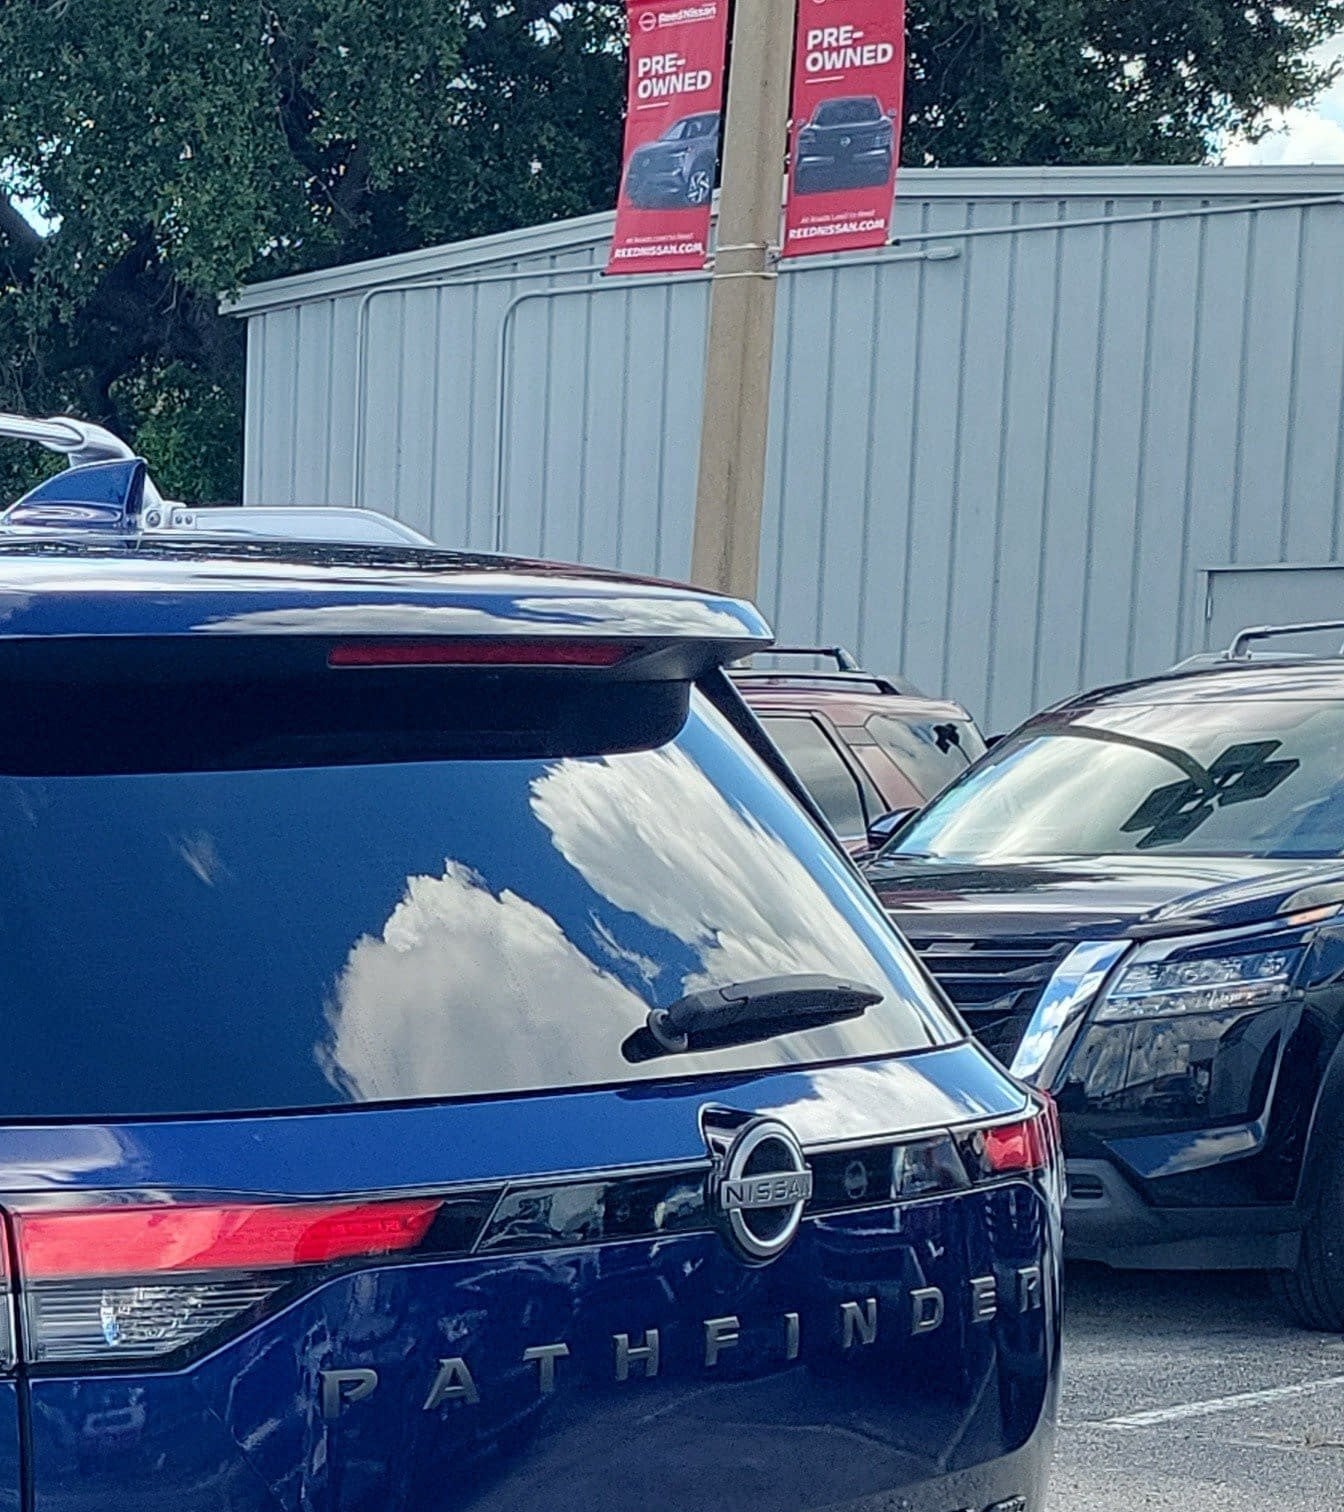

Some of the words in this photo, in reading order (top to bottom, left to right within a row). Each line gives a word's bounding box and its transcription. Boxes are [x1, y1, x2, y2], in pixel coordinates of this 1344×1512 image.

[807, 25, 864, 51] PRE-
[637, 53, 687, 78] PRE-
[805, 43, 894, 72] OWNED
[637, 70, 712, 99] OWNED
[320, 1265, 1041, 1420] PATHFINDER
